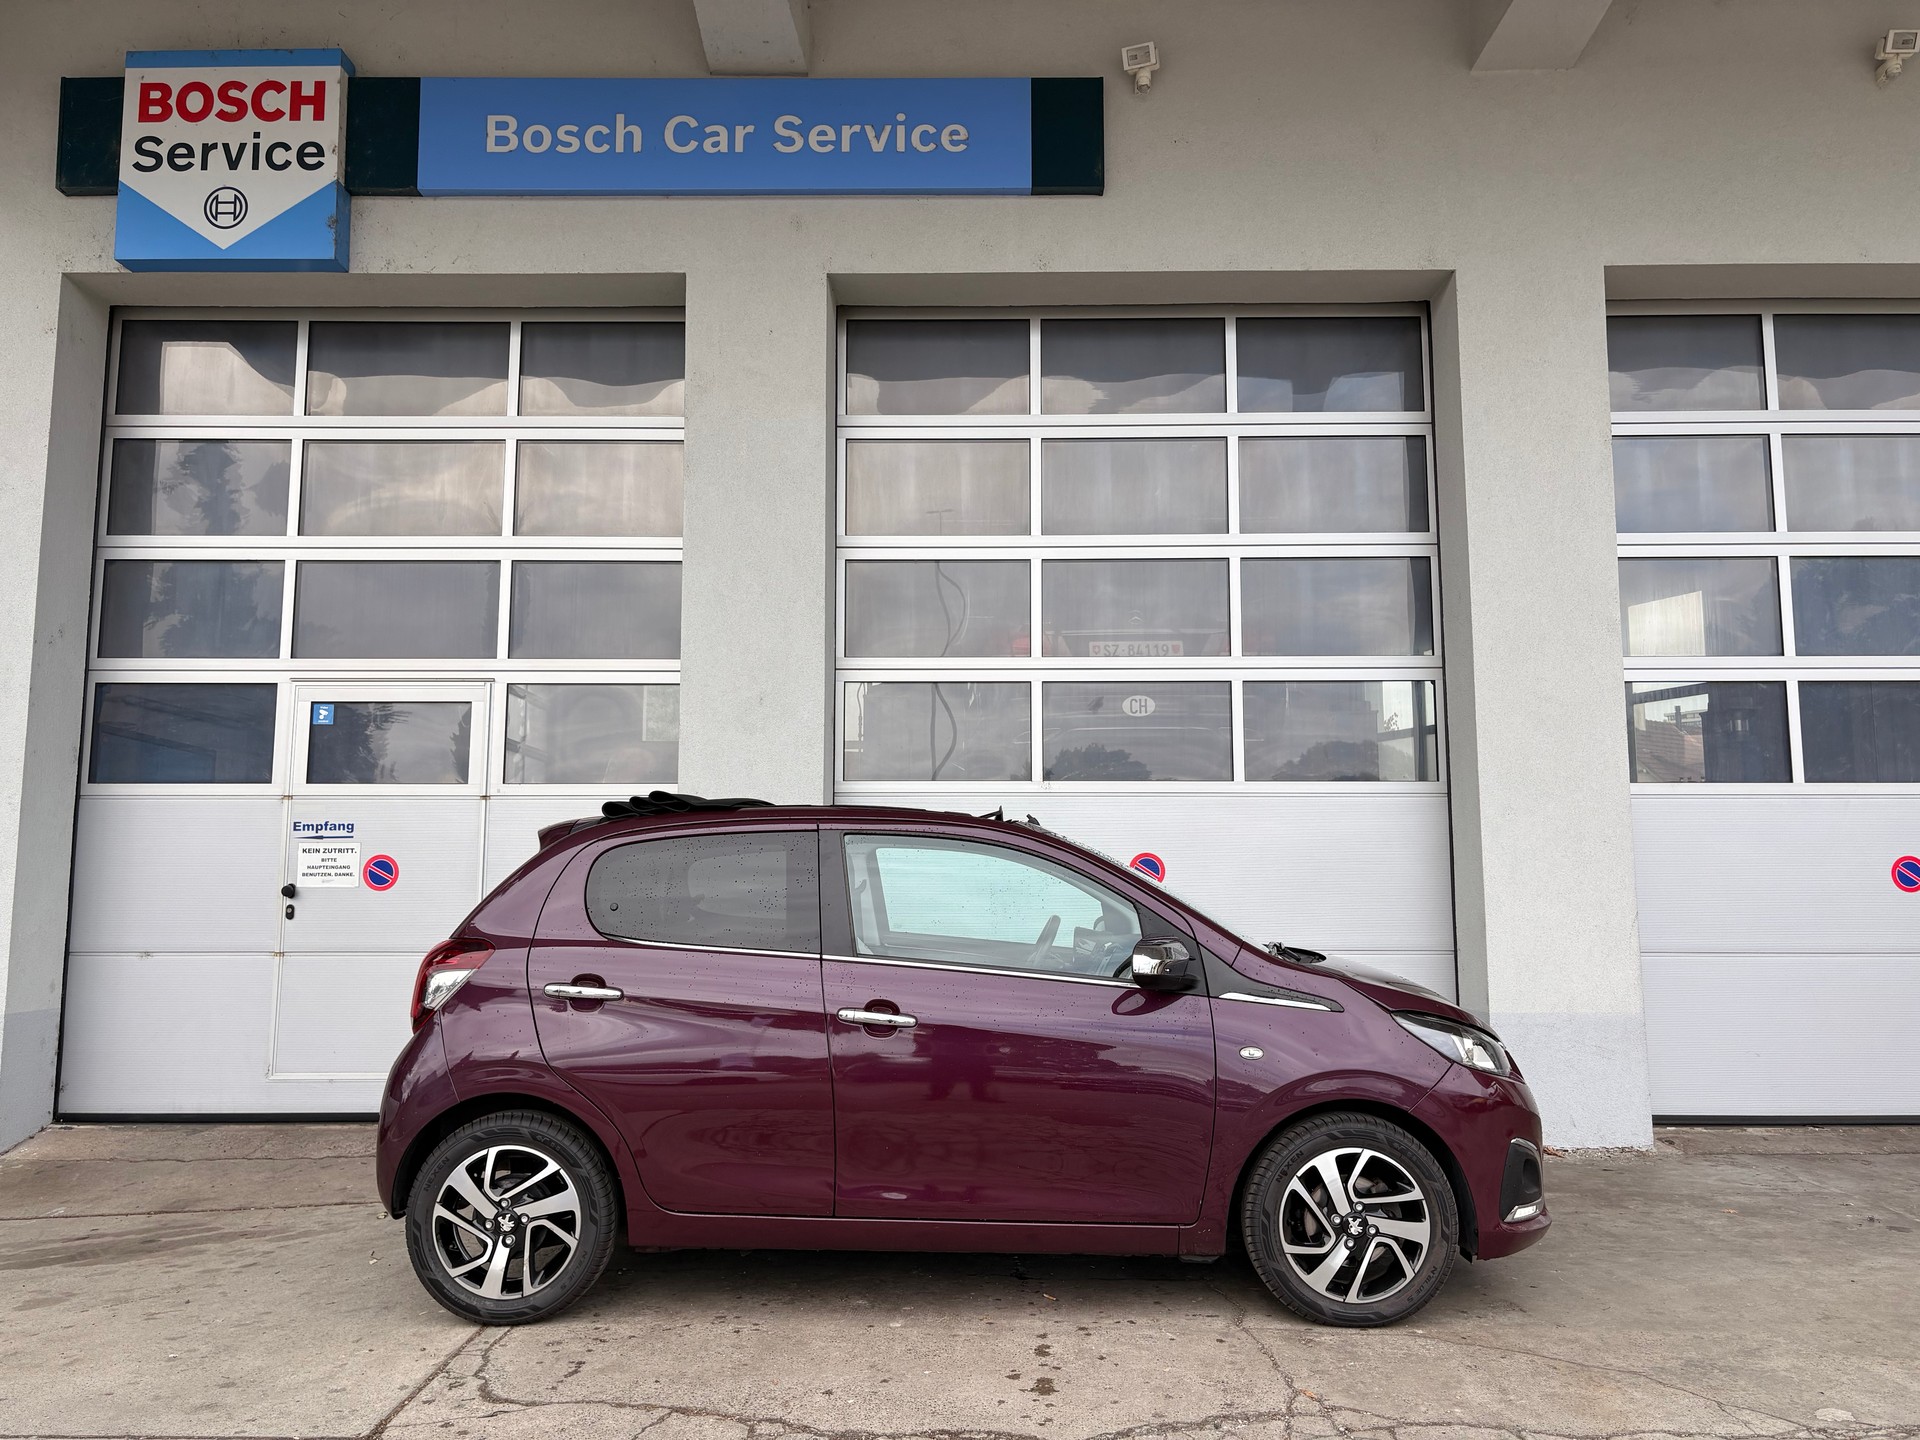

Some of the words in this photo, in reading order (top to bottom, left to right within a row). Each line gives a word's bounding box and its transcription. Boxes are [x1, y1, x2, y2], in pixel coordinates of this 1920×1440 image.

[138, 80, 326, 123] BOSCH
[486, 113, 643, 154] Bosch
[663, 114, 755, 154] Car
[772, 112, 970, 154] Service
[132, 131, 326, 173] Service
[1129, 698, 1148, 714] CH
[293, 821, 354, 834] Empfang
[423, 1156, 450, 1192] NEXEN
[1275, 1150, 1304, 1183] NEXEN
